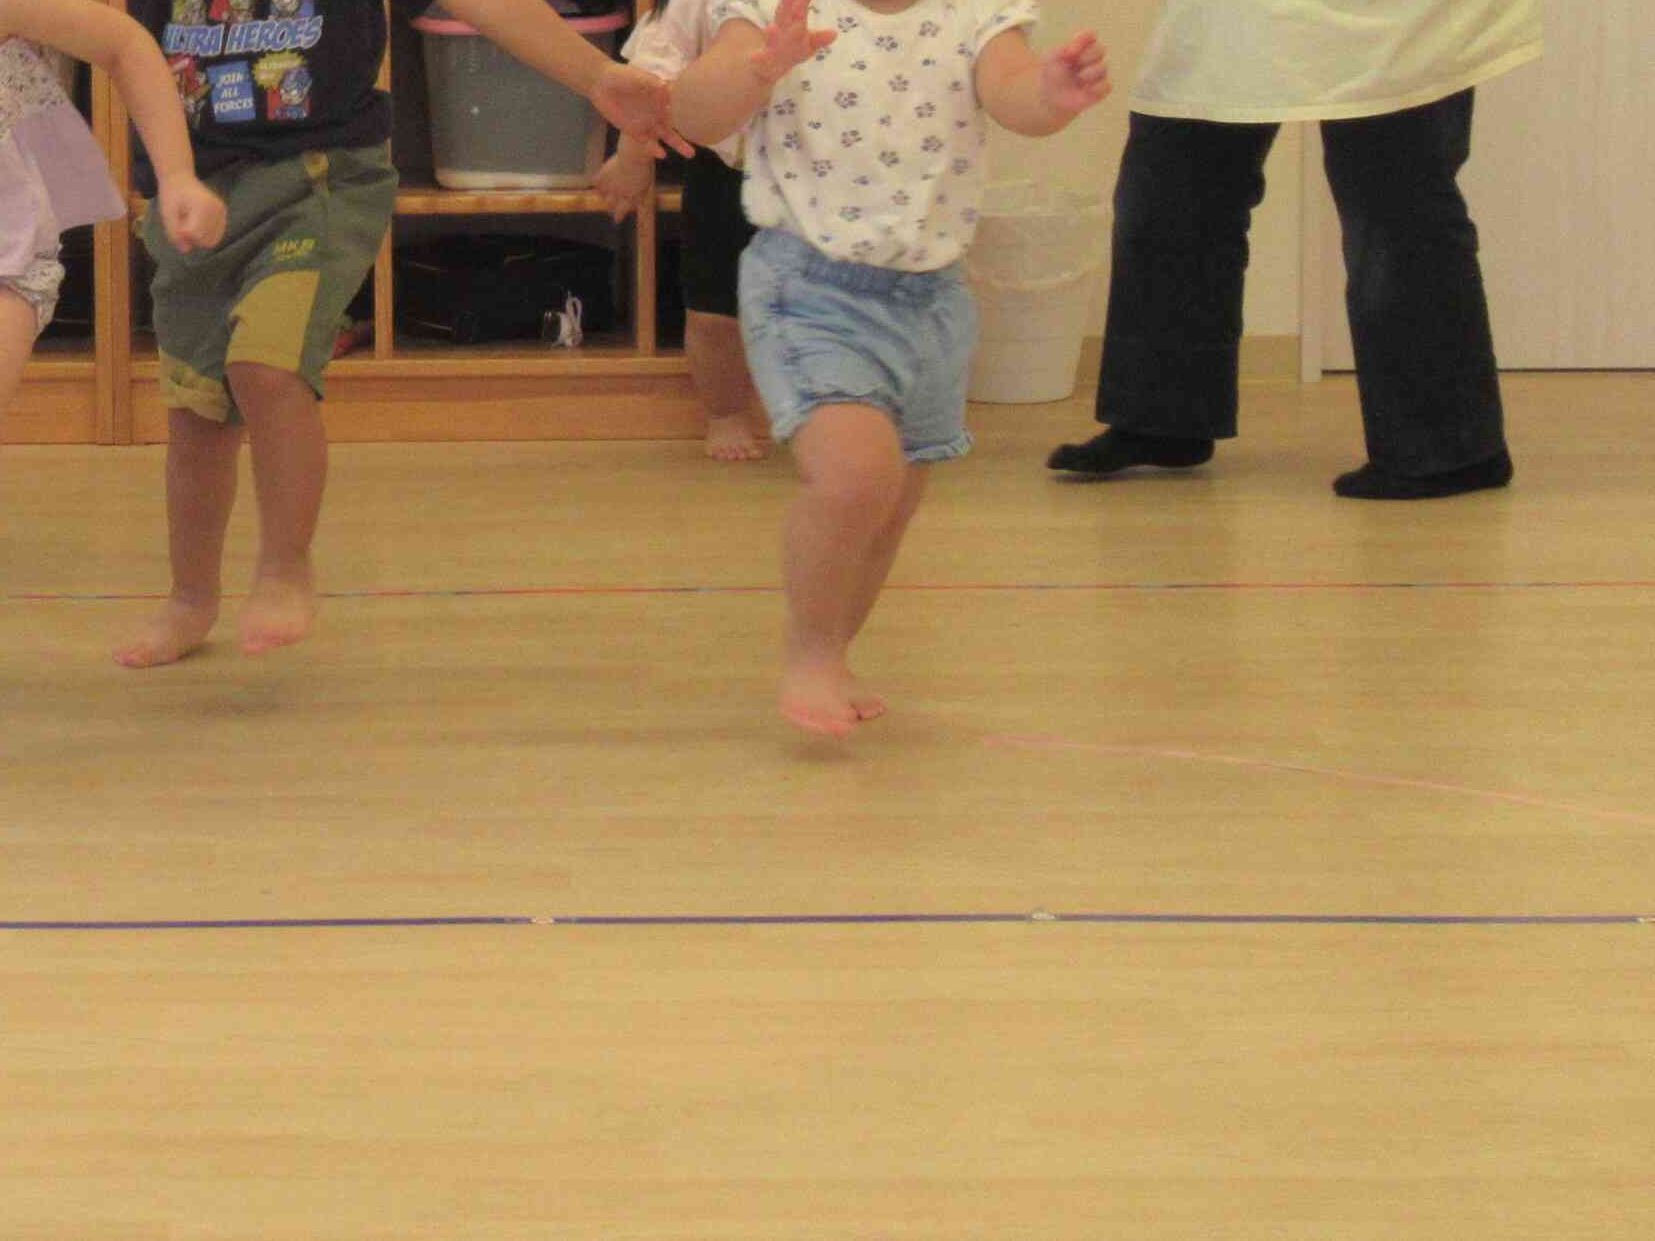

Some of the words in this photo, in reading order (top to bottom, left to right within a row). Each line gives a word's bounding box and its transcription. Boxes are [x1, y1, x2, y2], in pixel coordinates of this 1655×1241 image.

[163, 23, 225, 56] ULTRA
[225, 15, 323, 55] HEROES
[217, 71, 244, 87] JOIN
[220, 87, 241, 100] ALL
[214, 98, 254, 114] FORCES
